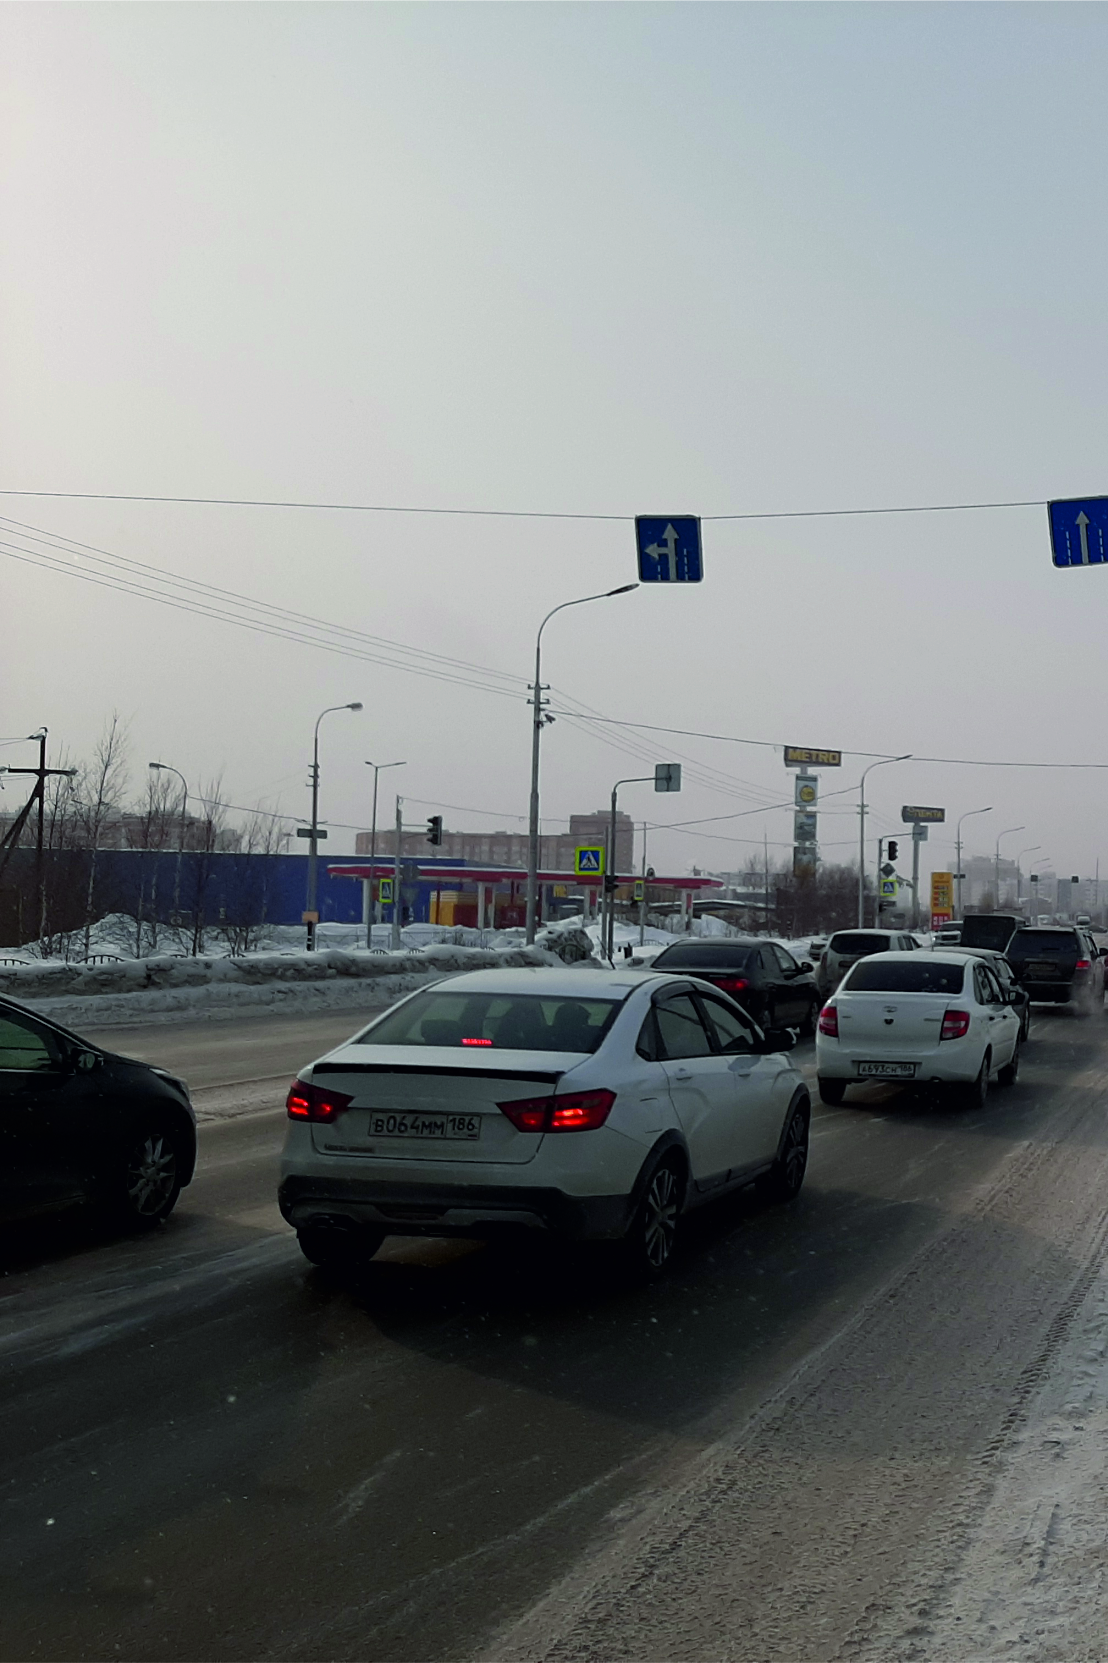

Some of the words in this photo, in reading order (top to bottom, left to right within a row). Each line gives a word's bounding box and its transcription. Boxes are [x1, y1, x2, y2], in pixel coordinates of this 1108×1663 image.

[788, 749, 840, 764] METRO
[374, 1115, 445, 1135] В064ММ
[449, 1117, 475, 1131] 186
